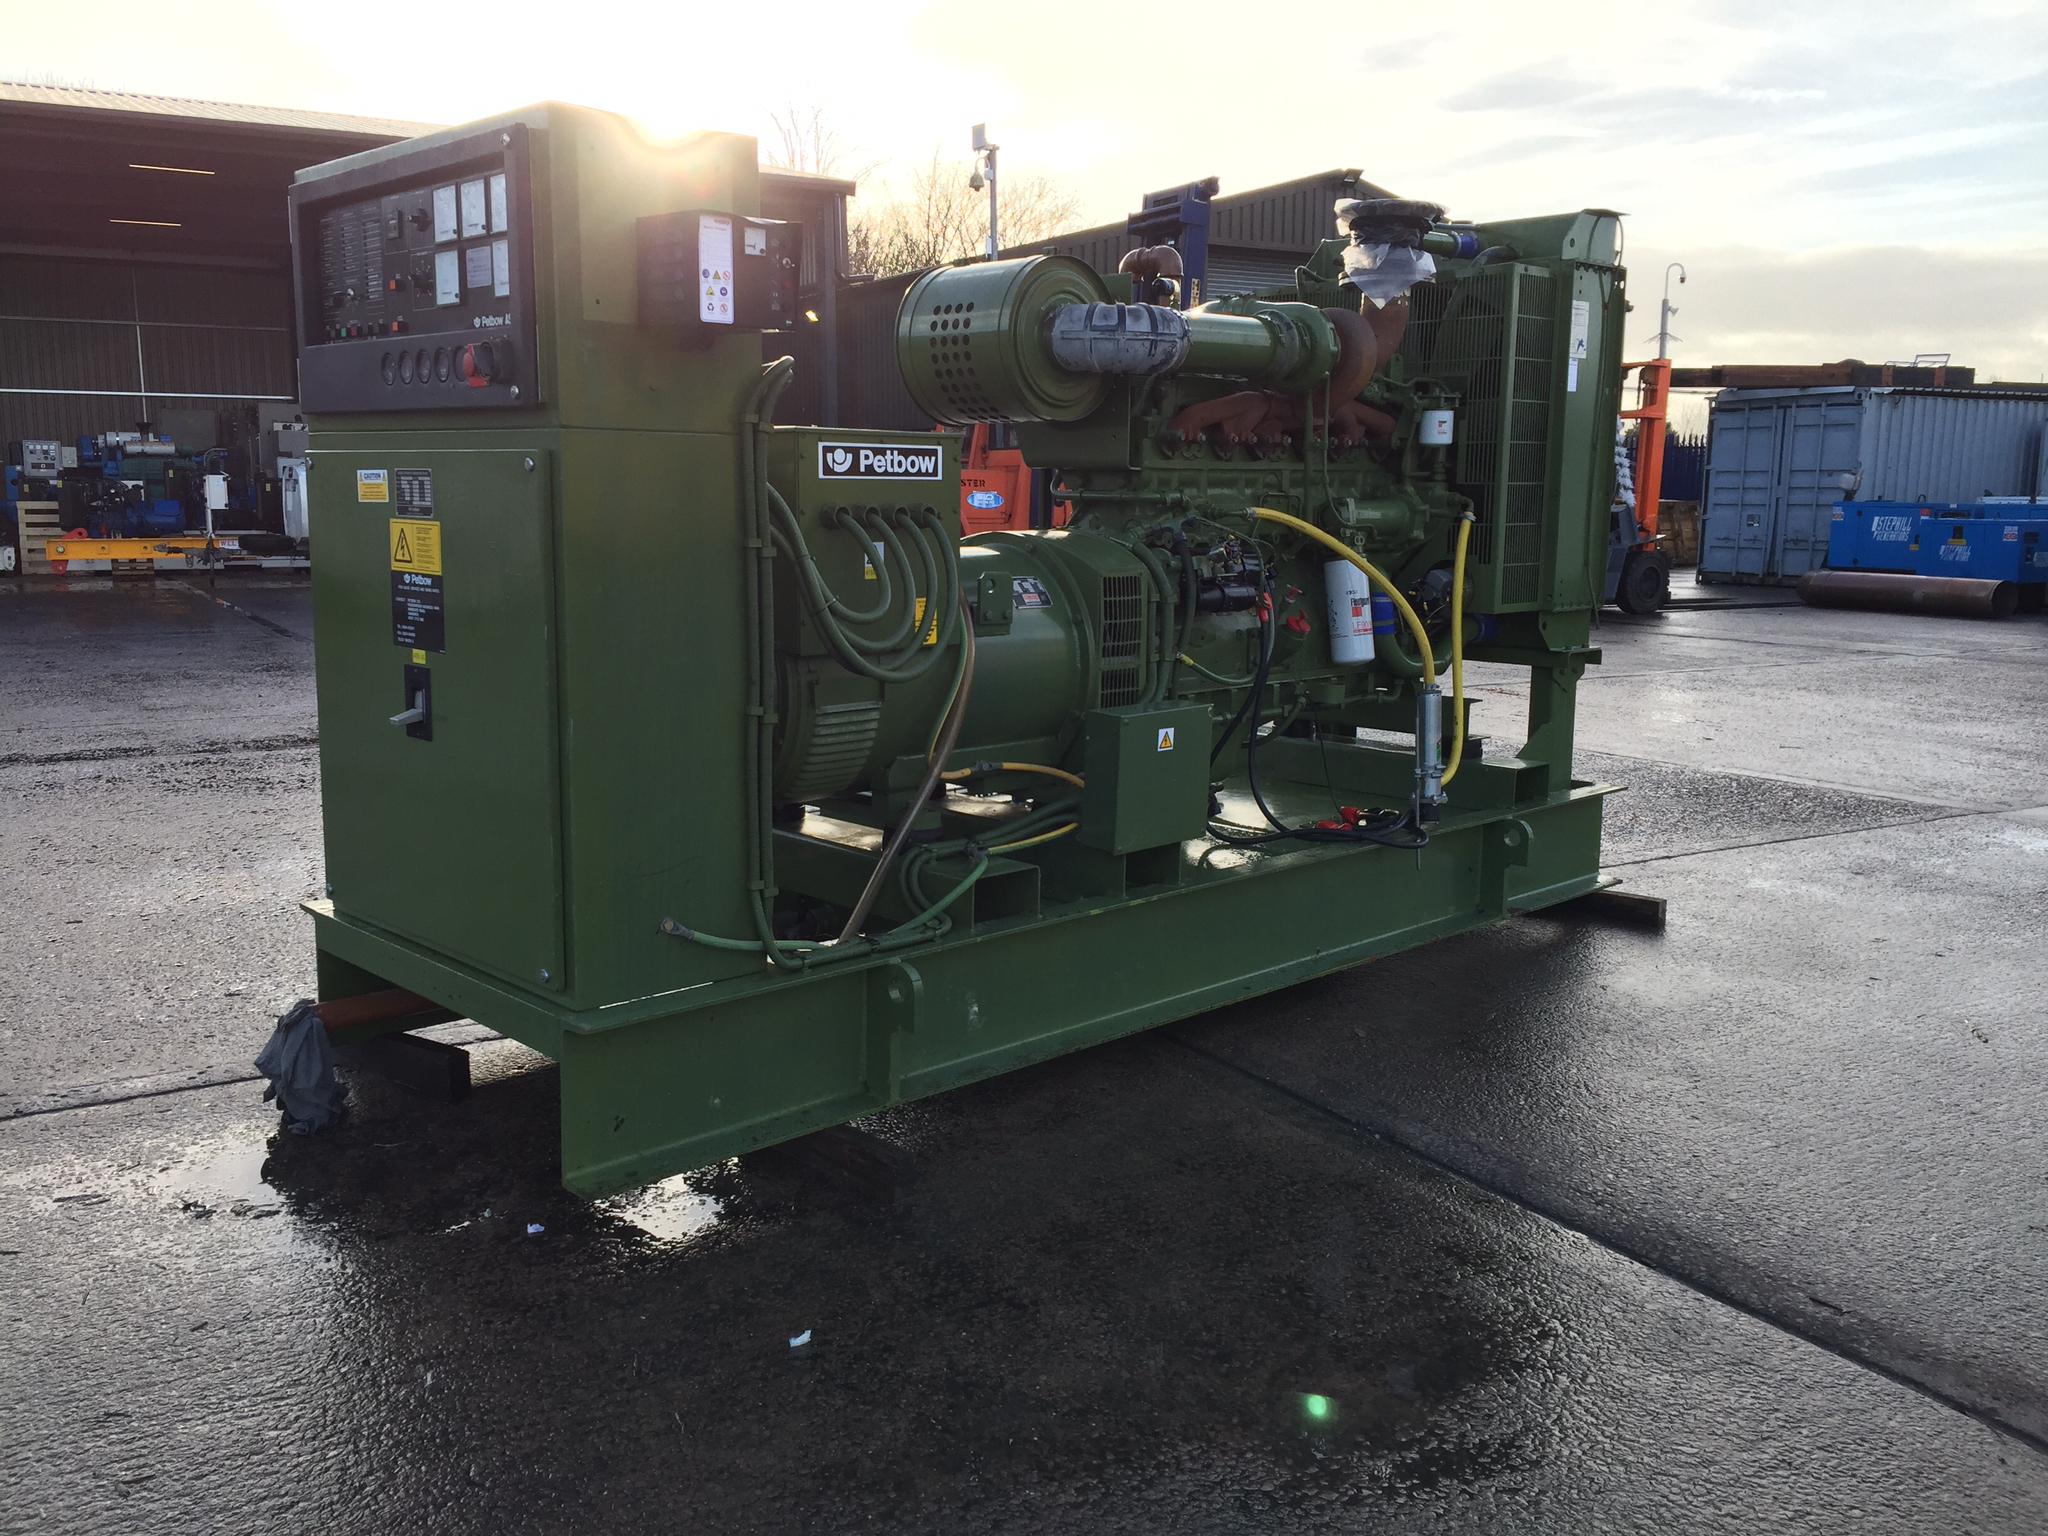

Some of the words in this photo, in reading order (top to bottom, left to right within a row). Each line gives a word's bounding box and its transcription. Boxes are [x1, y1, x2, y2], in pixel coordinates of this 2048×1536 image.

[860, 449, 936, 473] Petbow
[1877, 516, 1912, 532] STEPHILL
[411, 574, 432, 585] Petbow
